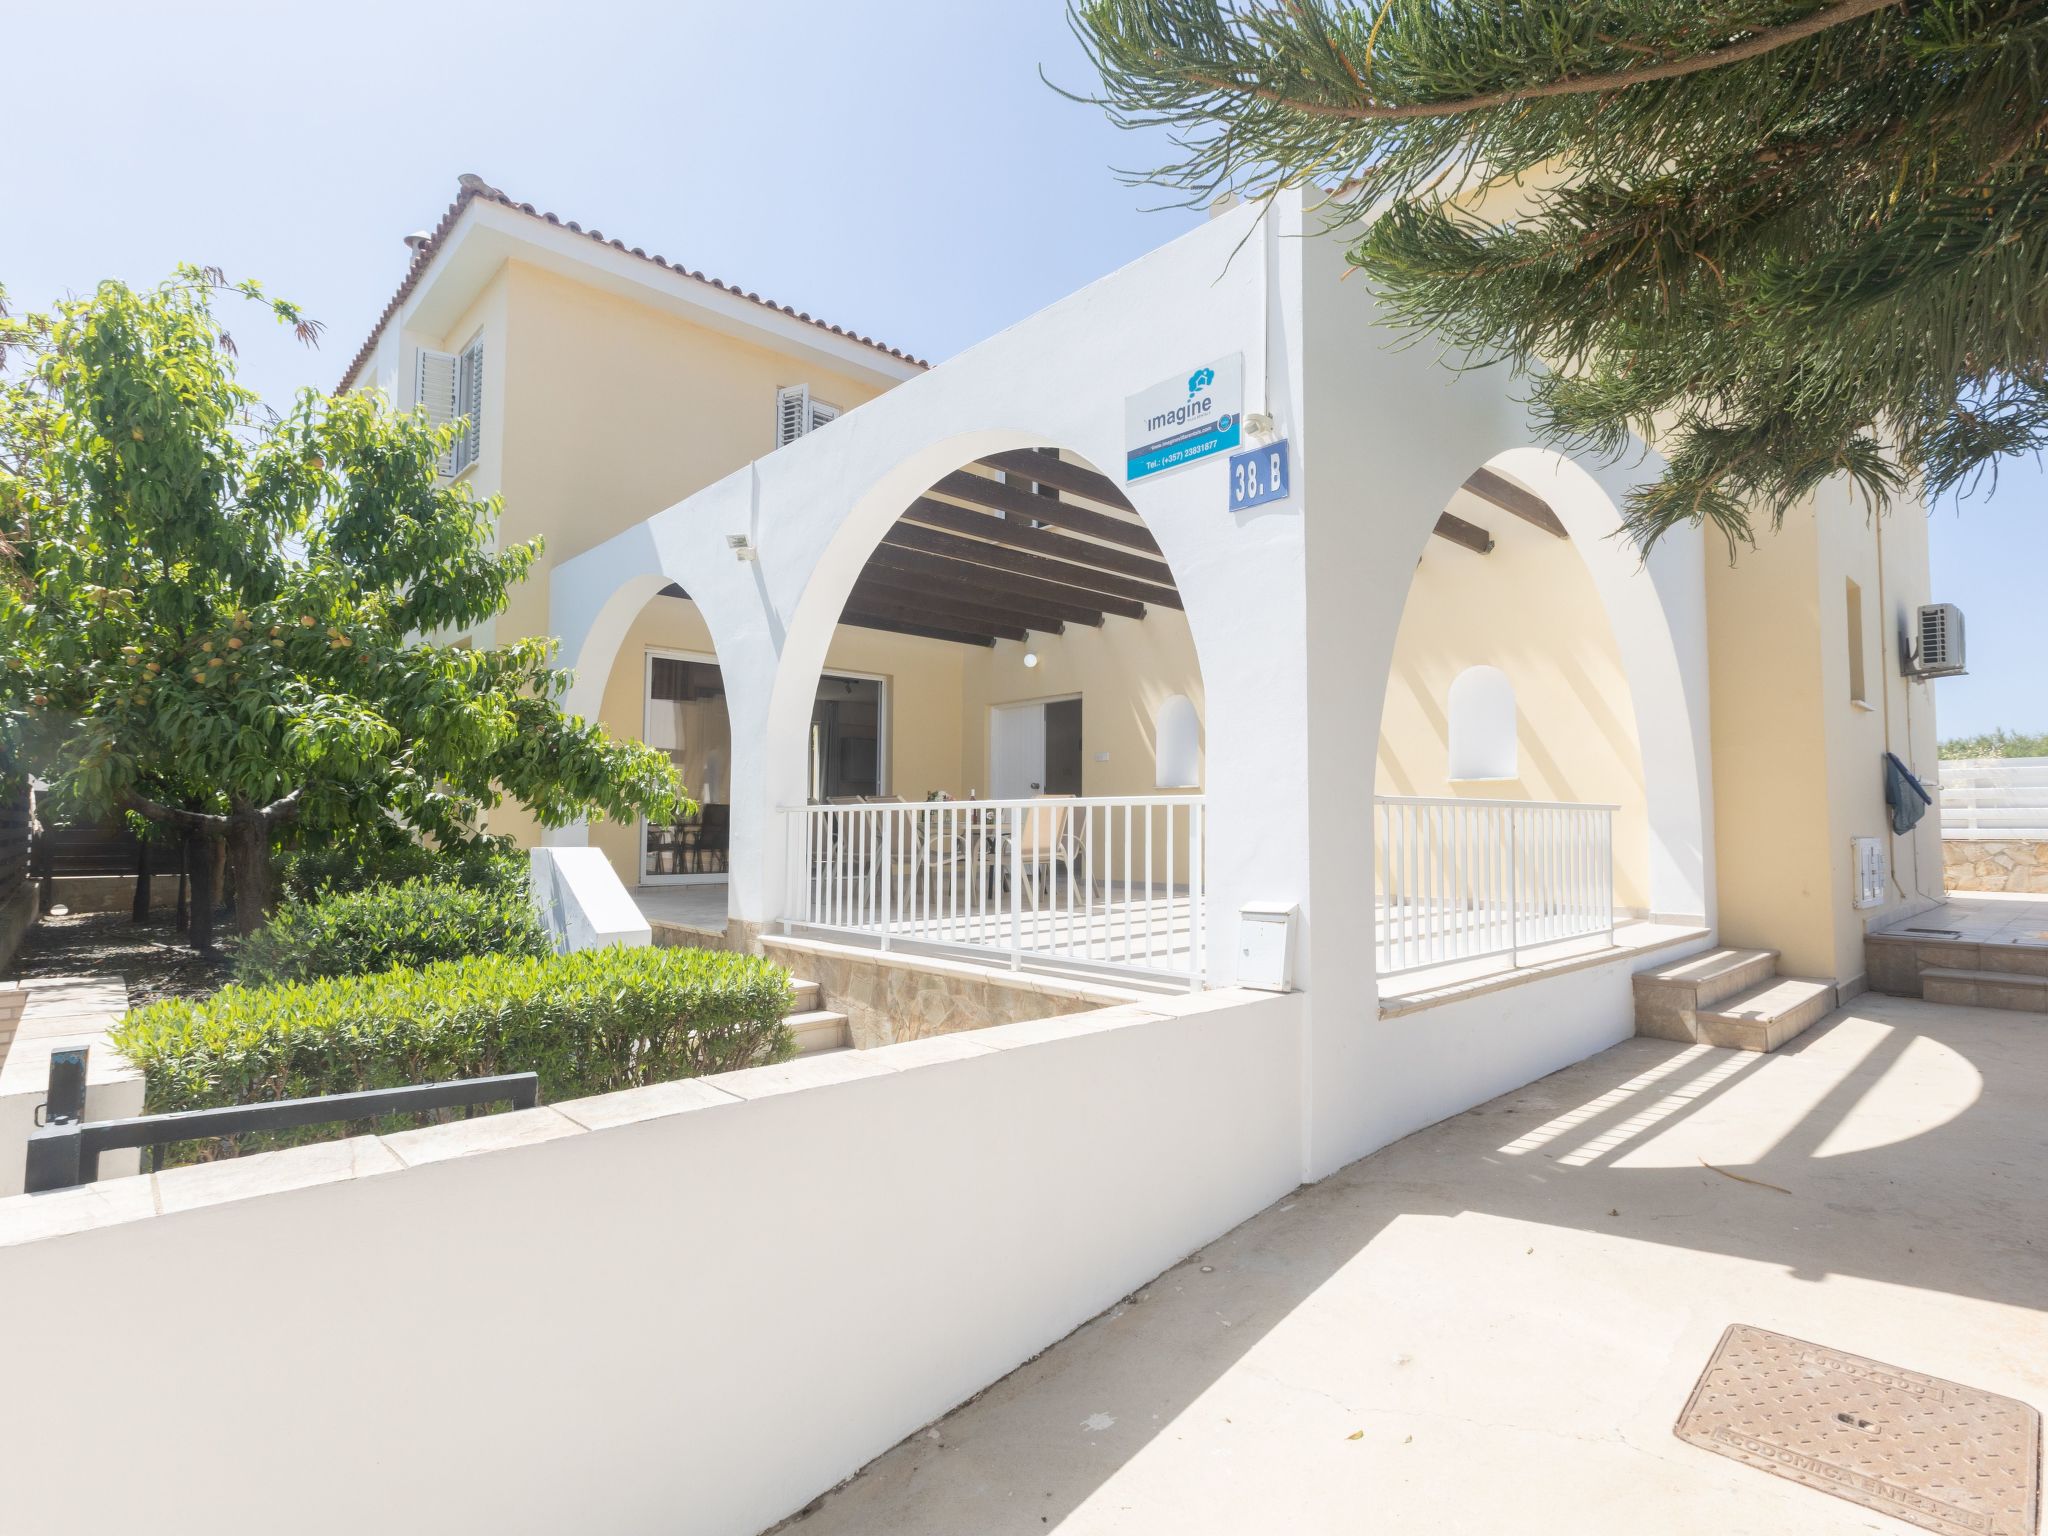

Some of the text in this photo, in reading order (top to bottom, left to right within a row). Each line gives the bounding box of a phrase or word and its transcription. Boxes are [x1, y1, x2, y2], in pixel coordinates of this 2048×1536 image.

[1147, 396, 1212, 432] imagine
[1146, 440, 1218, 470] Tel.: (+357) 23831877
[1270, 453, 1281, 492] B
[1717, 1428, 1855, 1486] ECODOMICA
